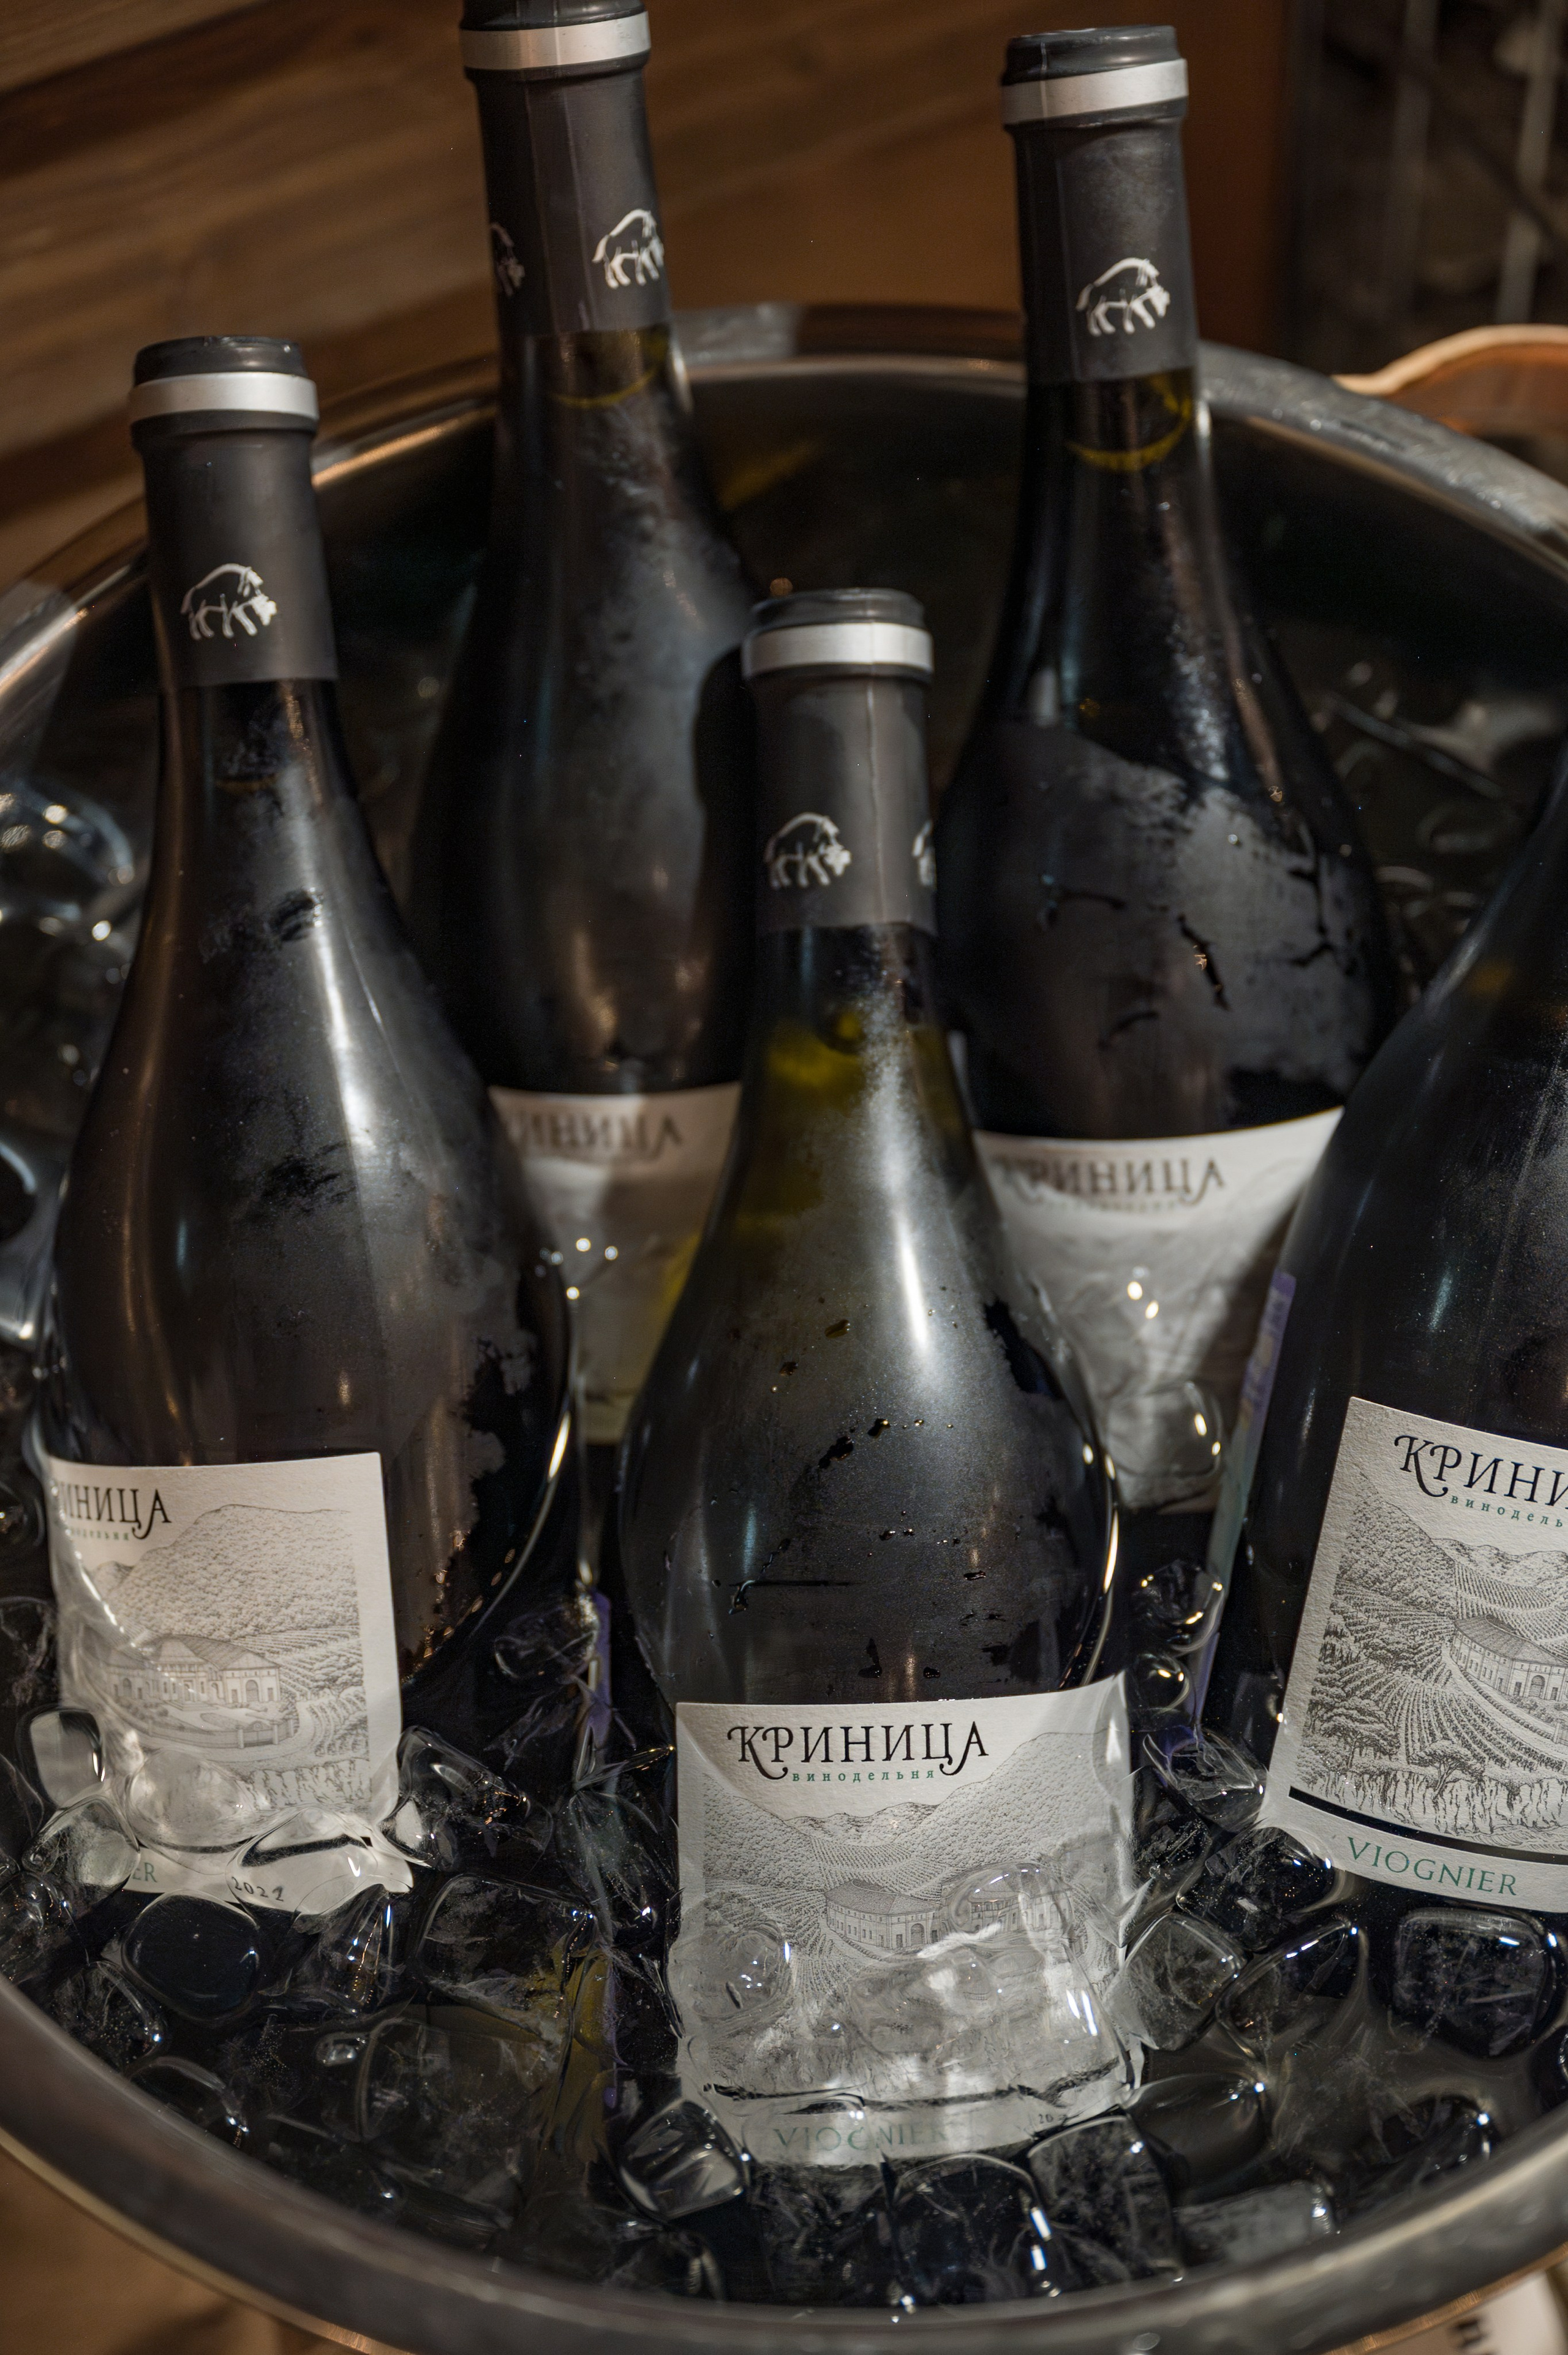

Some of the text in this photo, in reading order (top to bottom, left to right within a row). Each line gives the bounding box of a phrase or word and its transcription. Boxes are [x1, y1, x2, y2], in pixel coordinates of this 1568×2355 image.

[1394, 1435, 1568, 1510] КРИНИ
[59, 1480, 172, 1540] ИНИЦА
[1450, 1495, 1564, 1528] винодель
[727, 1720, 989, 1780] КРИНИЦА
[792, 1769, 935, 1783] винодельня
[1348, 1836, 1517, 1896] VIOGNIER
